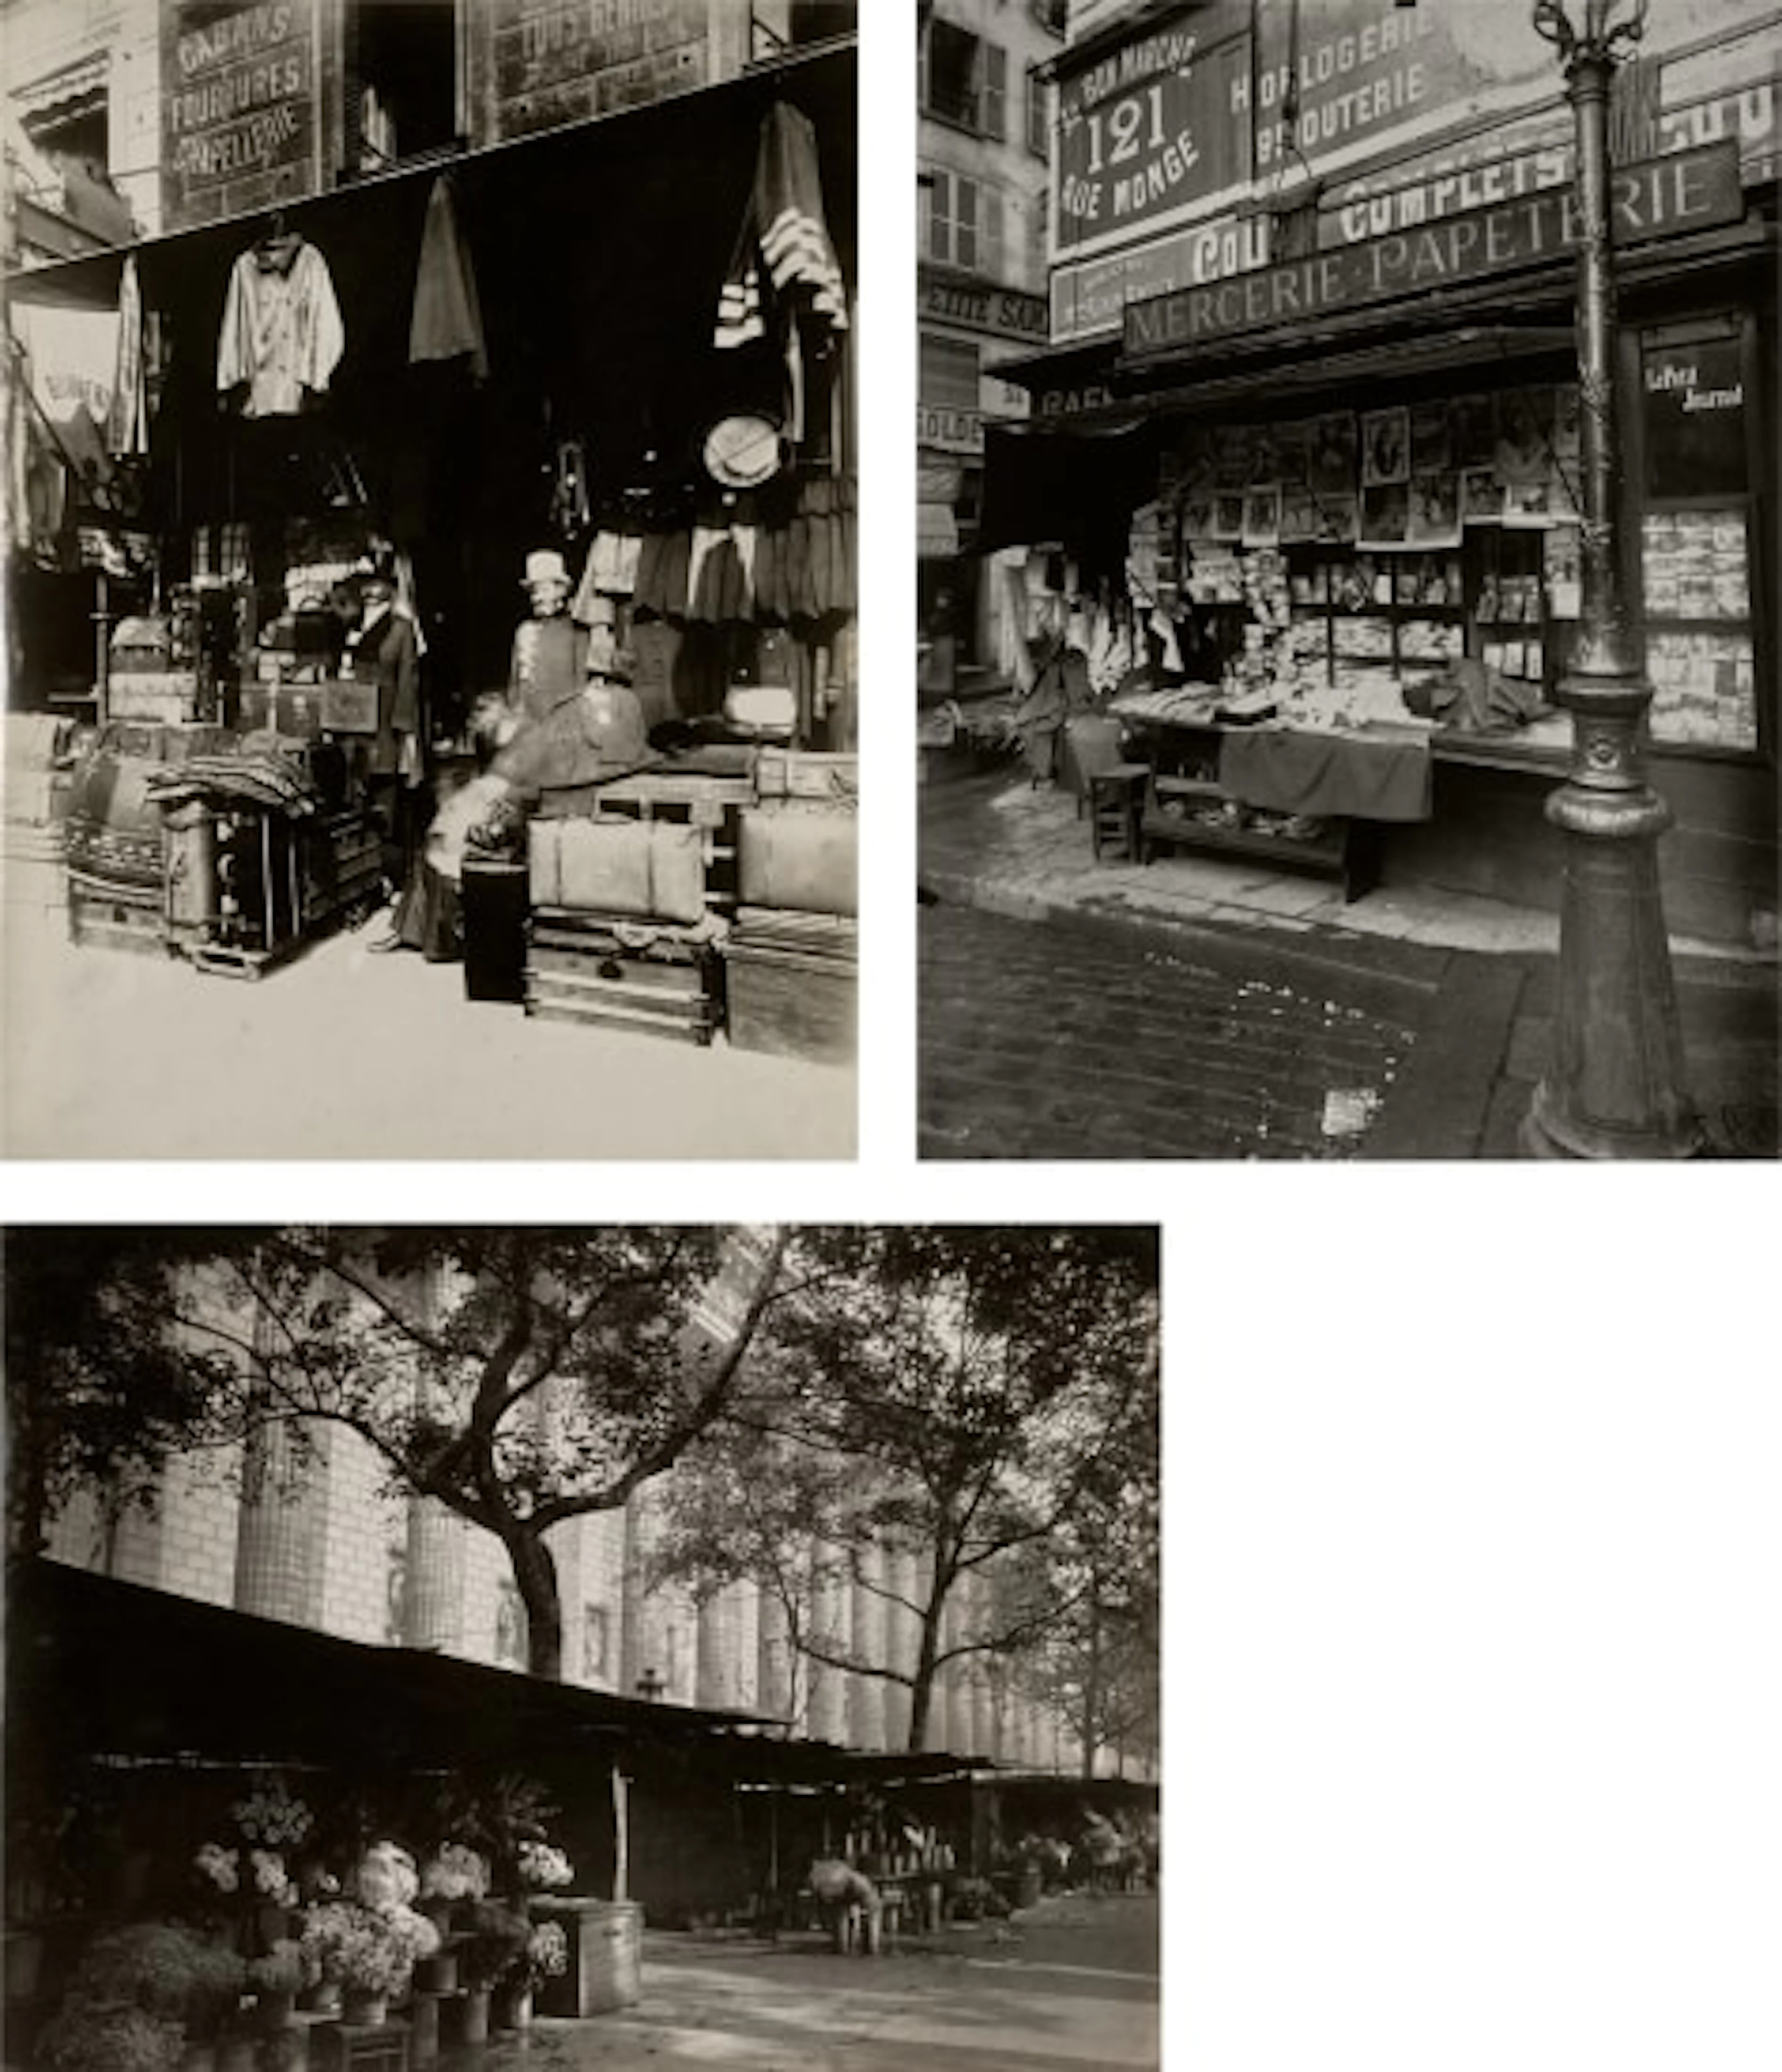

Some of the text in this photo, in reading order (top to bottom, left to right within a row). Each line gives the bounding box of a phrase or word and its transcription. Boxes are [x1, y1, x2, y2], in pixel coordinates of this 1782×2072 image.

[1087, 84, 1166, 175] 121
[1256, 62, 1426, 165] BIOUTERIE
[1114, 128, 1201, 217] MONGE
[1124, 157, 1711, 352] MERCERIE PAPETERIE
